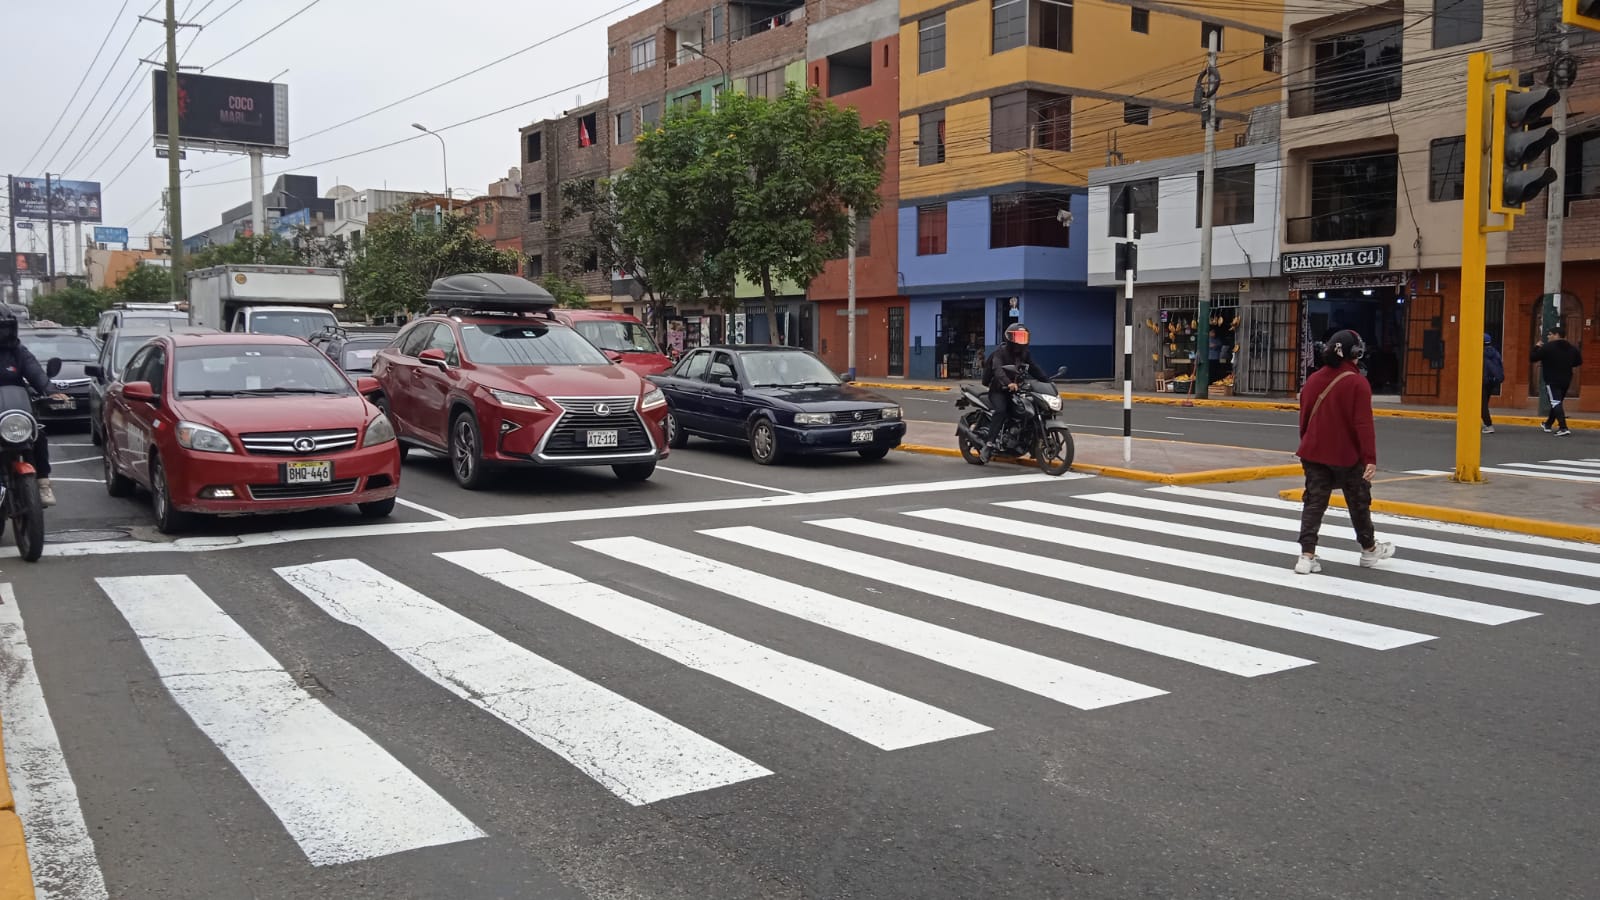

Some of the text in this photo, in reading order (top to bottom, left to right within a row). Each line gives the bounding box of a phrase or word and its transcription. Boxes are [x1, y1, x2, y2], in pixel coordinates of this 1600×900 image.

[228, 95, 254, 111] COCO
[1290, 250, 1374, 269] BARBERIA G4
[588, 434, 617, 445] ATZ-112
[289, 466, 329, 480] BHQ-446
